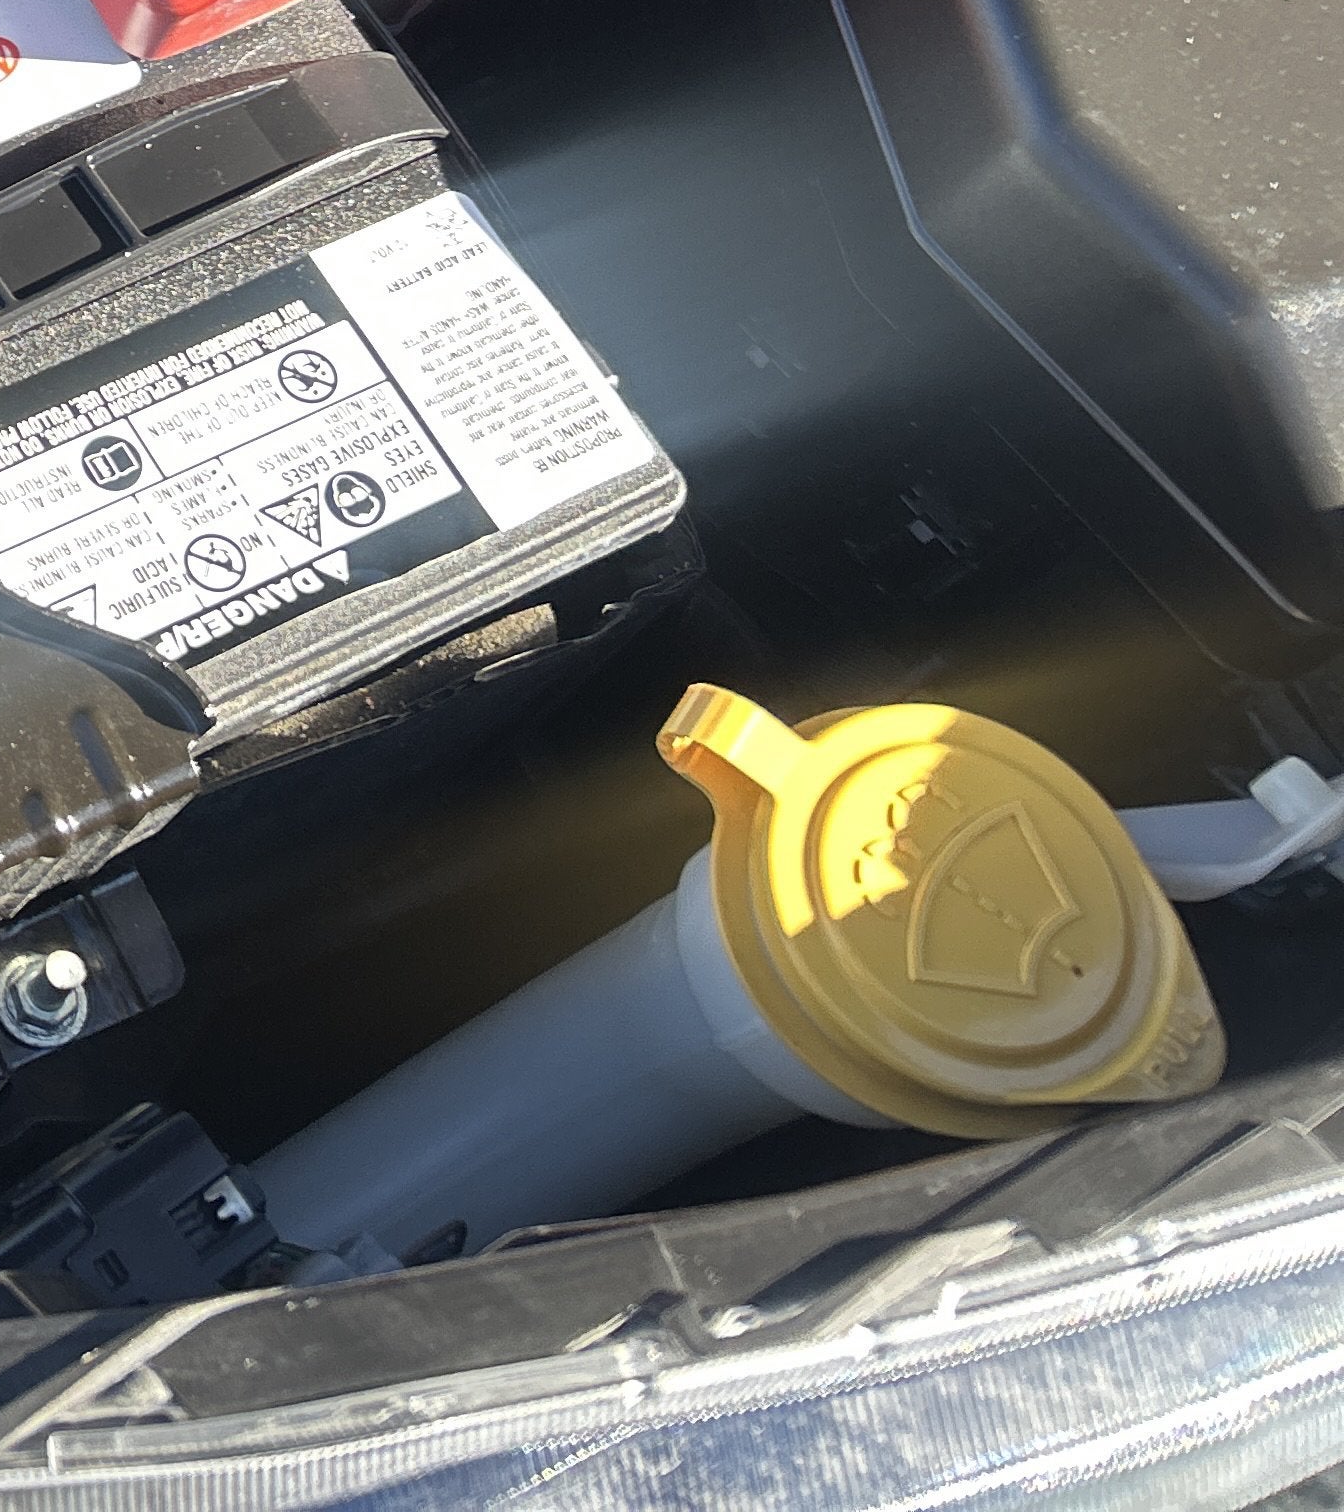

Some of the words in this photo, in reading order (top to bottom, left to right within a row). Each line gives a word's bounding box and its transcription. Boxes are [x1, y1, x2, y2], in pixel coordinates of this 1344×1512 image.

[384, 265, 431, 294] BATTERY
[107, 374, 179, 417] EXPLOSION
[146, 401, 211, 440] CHILDREN
[328, 418, 409, 466] EXPLOSIVE
[382, 438, 421, 467] EYES
[545, 424, 622, 467] PROPOSITION
[279, 454, 329, 488] GASES
[383, 458, 437, 494] SHIELD
[238, 530, 262, 553] NO
[131, 555, 169, 584] ACID
[106, 574, 183, 620] SULFURIC
[156, 567, 325, 662] DANGER/P
